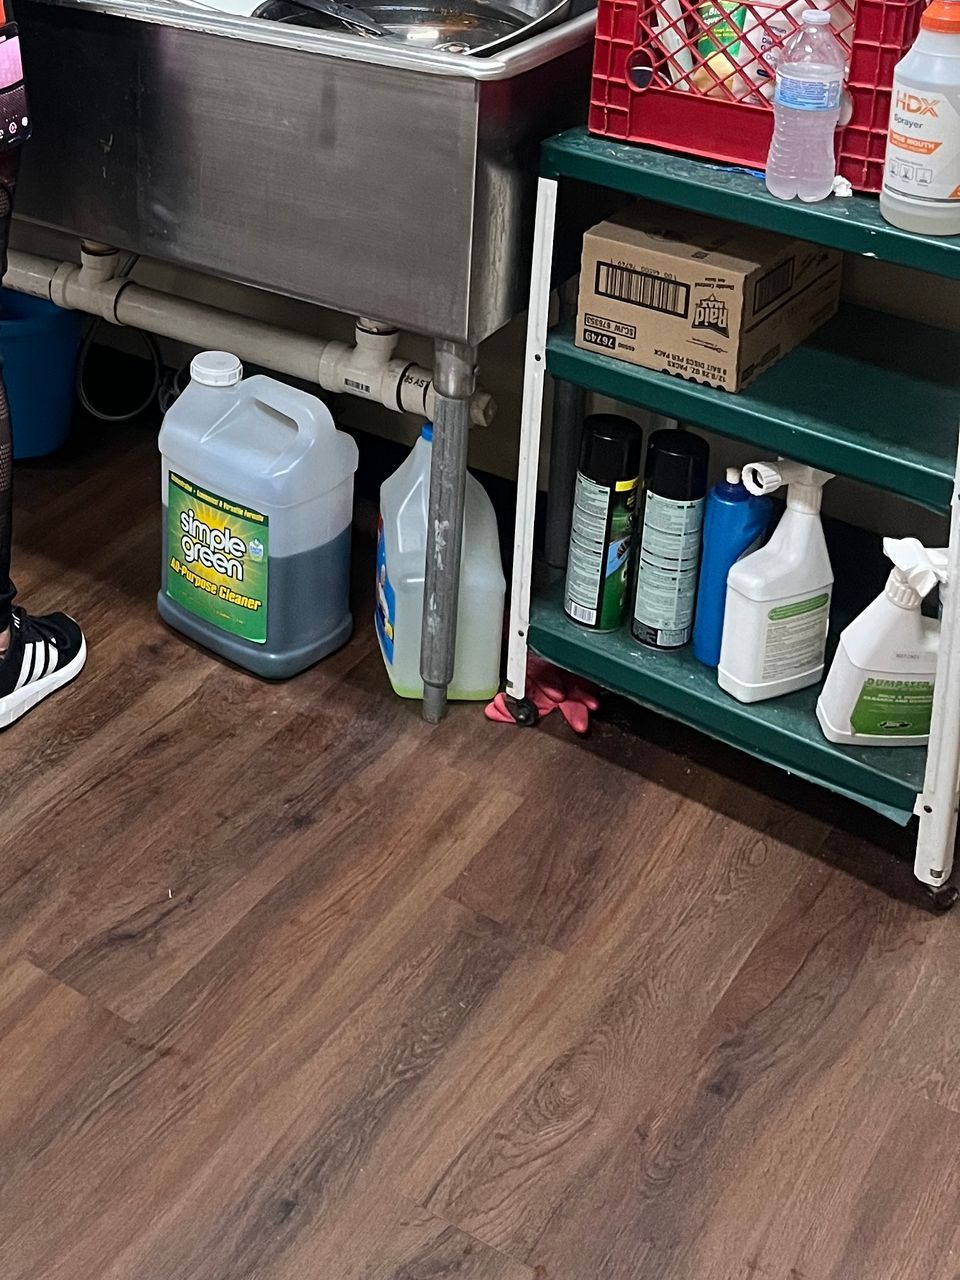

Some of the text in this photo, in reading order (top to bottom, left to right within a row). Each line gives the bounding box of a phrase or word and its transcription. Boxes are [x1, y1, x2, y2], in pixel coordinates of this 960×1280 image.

[895, 89, 941, 118] HDX
[894, 113, 924, 129] Sprayer
[694, 307, 727, 328] Raid
[585, 331, 614, 347] 76749
[667, 360, 688, 372] PACKS
[180, 509, 246, 559] simple
[181, 533, 244, 581] green
[219, 585, 262, 611] Cleaner
